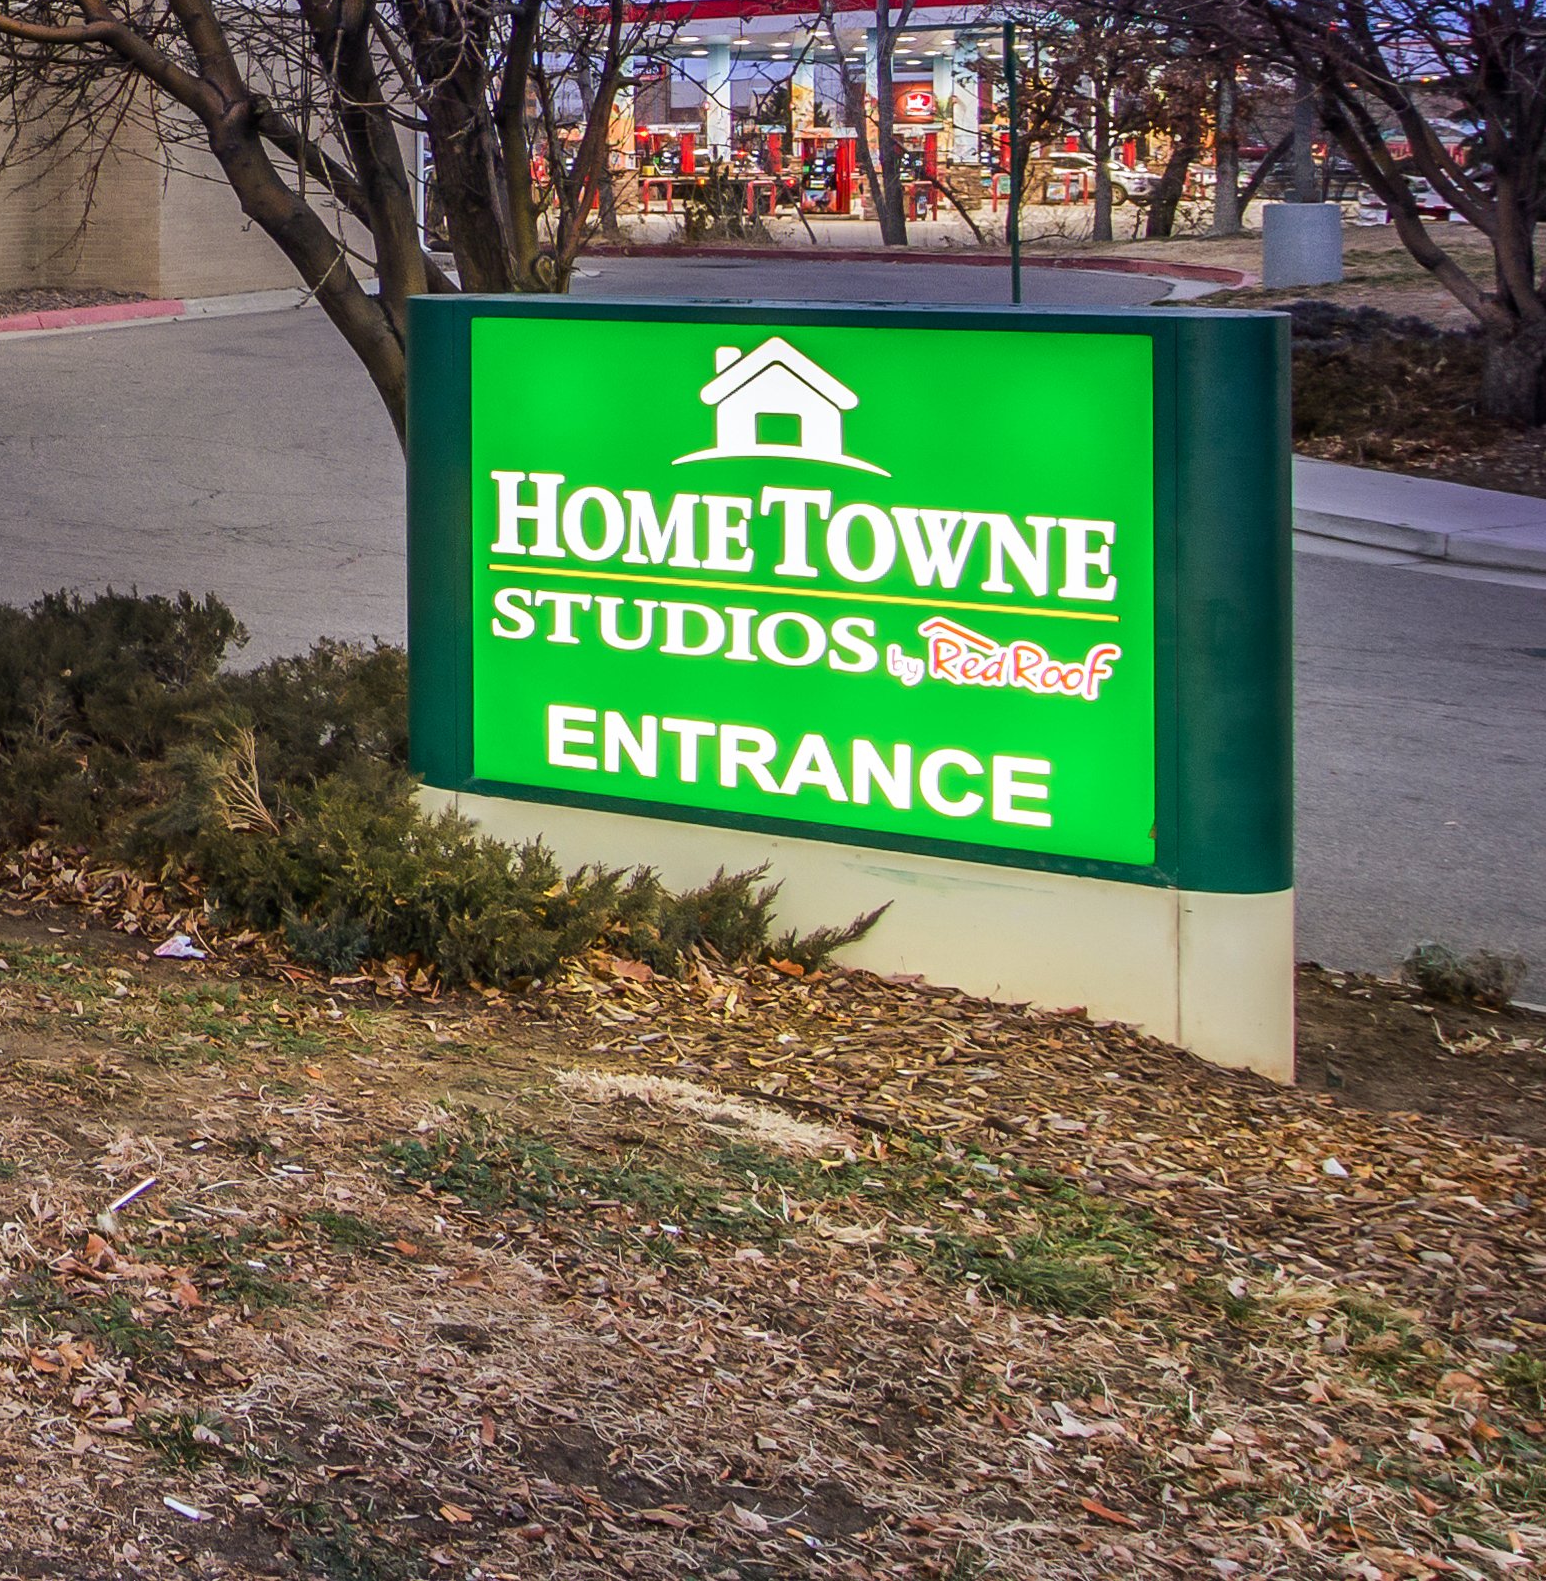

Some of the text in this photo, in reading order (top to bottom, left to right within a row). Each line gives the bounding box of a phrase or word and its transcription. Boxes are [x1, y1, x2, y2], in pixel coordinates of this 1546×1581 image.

[491, 588, 879, 673] STUDIOS
[887, 644, 925, 685] by
[548, 704, 1052, 827] ENTRANCE
